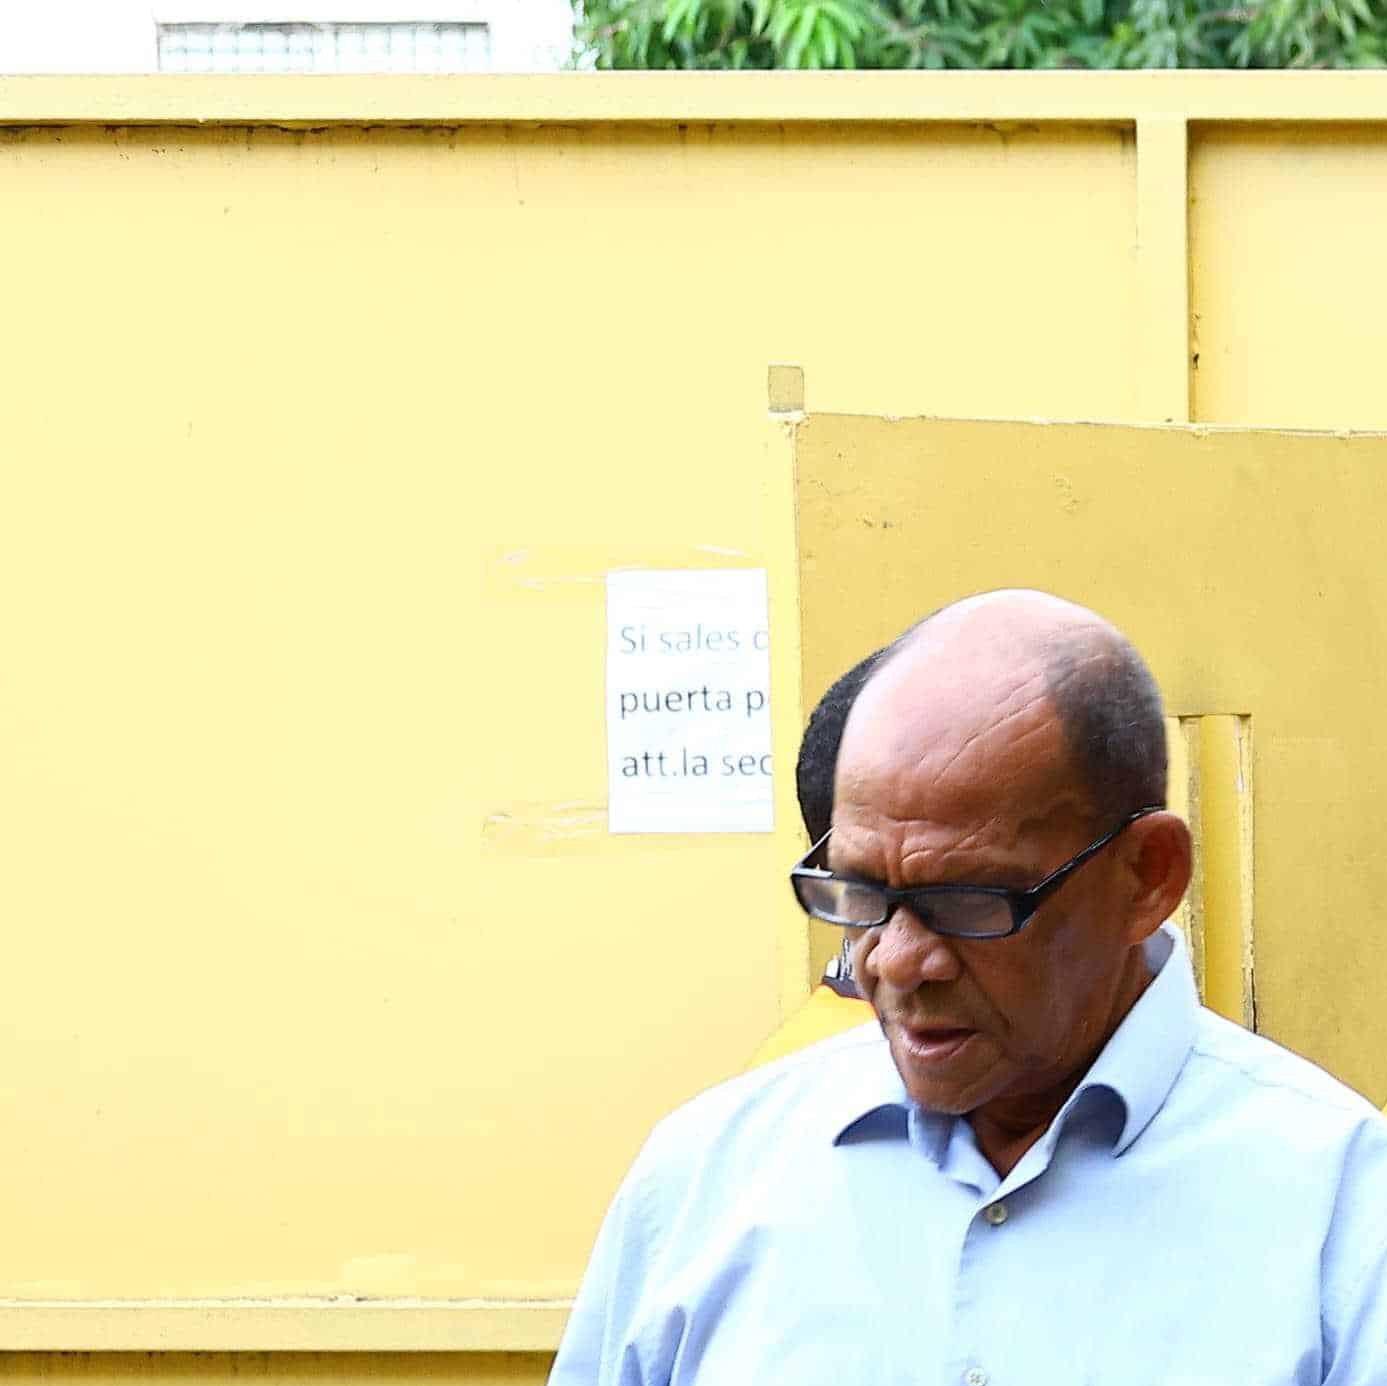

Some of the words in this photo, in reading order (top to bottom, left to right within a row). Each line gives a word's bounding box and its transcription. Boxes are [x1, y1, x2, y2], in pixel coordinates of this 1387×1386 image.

[620, 624, 646, 653] Si
[658, 623, 740, 652] sales
[620, 685, 731, 719] puerta
[622, 746, 708, 777] att.la
